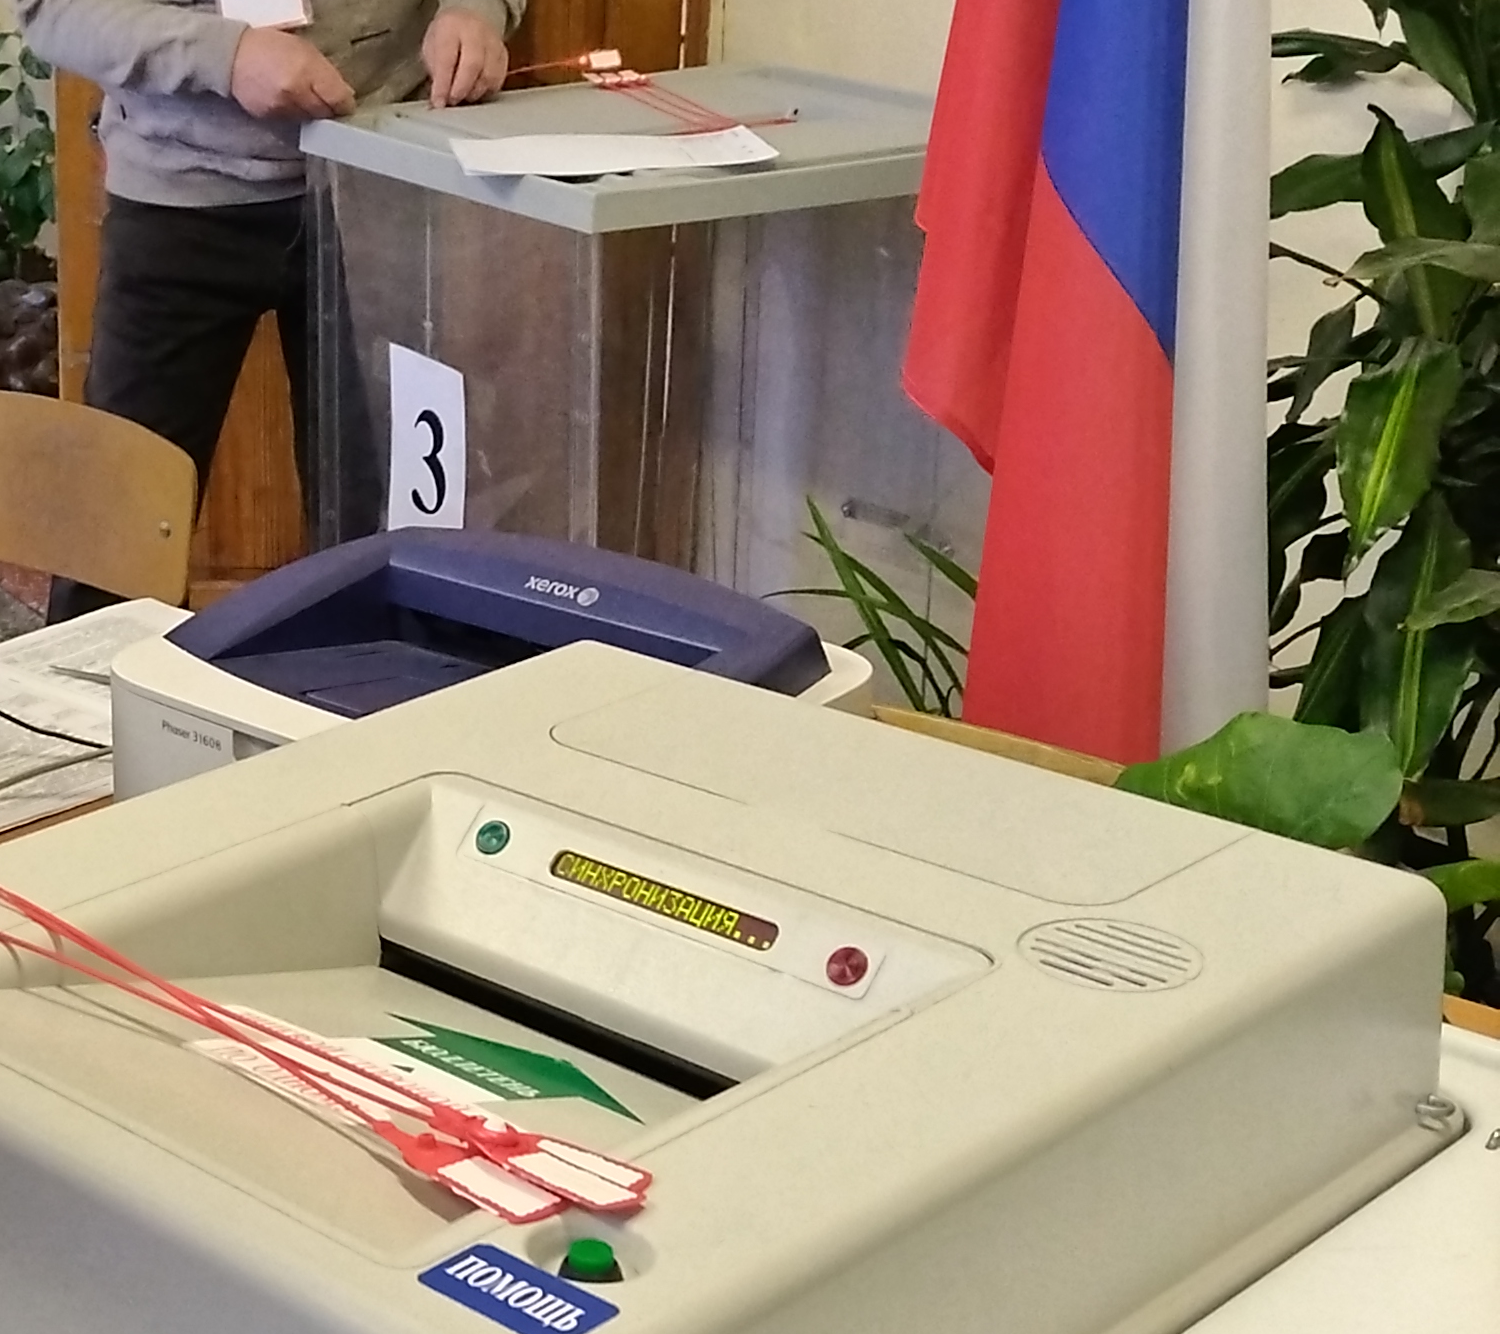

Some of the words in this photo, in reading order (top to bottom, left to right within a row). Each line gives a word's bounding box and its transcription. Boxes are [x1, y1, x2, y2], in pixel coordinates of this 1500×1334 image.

[411, 409, 446, 515] 3
[524, 575, 580, 600] xerox
[162, 719, 190, 739] Phaser
[444, 1254, 586, 1332] ПОМОЩЬ
